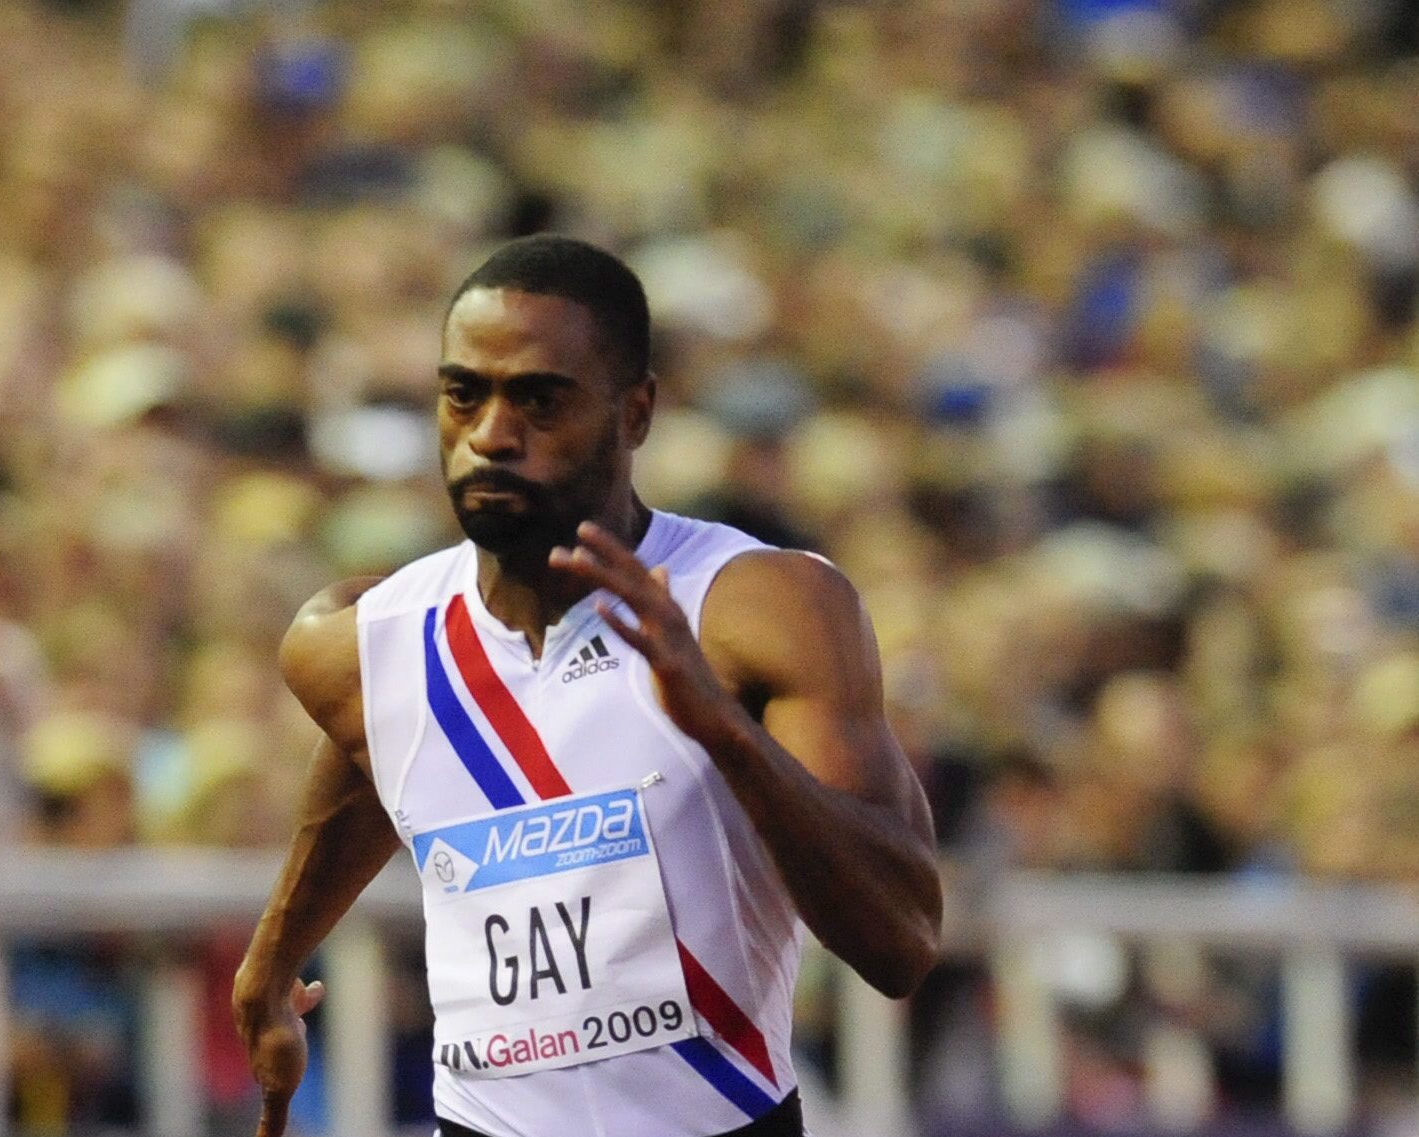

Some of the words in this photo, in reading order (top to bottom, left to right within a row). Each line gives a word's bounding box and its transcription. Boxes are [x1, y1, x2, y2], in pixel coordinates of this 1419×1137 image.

[562, 658, 619, 684] adidas
[555, 837, 641, 867] zoom-zoom
[485, 896, 592, 1006] GAY
[583, 1000, 683, 1050] 2009
